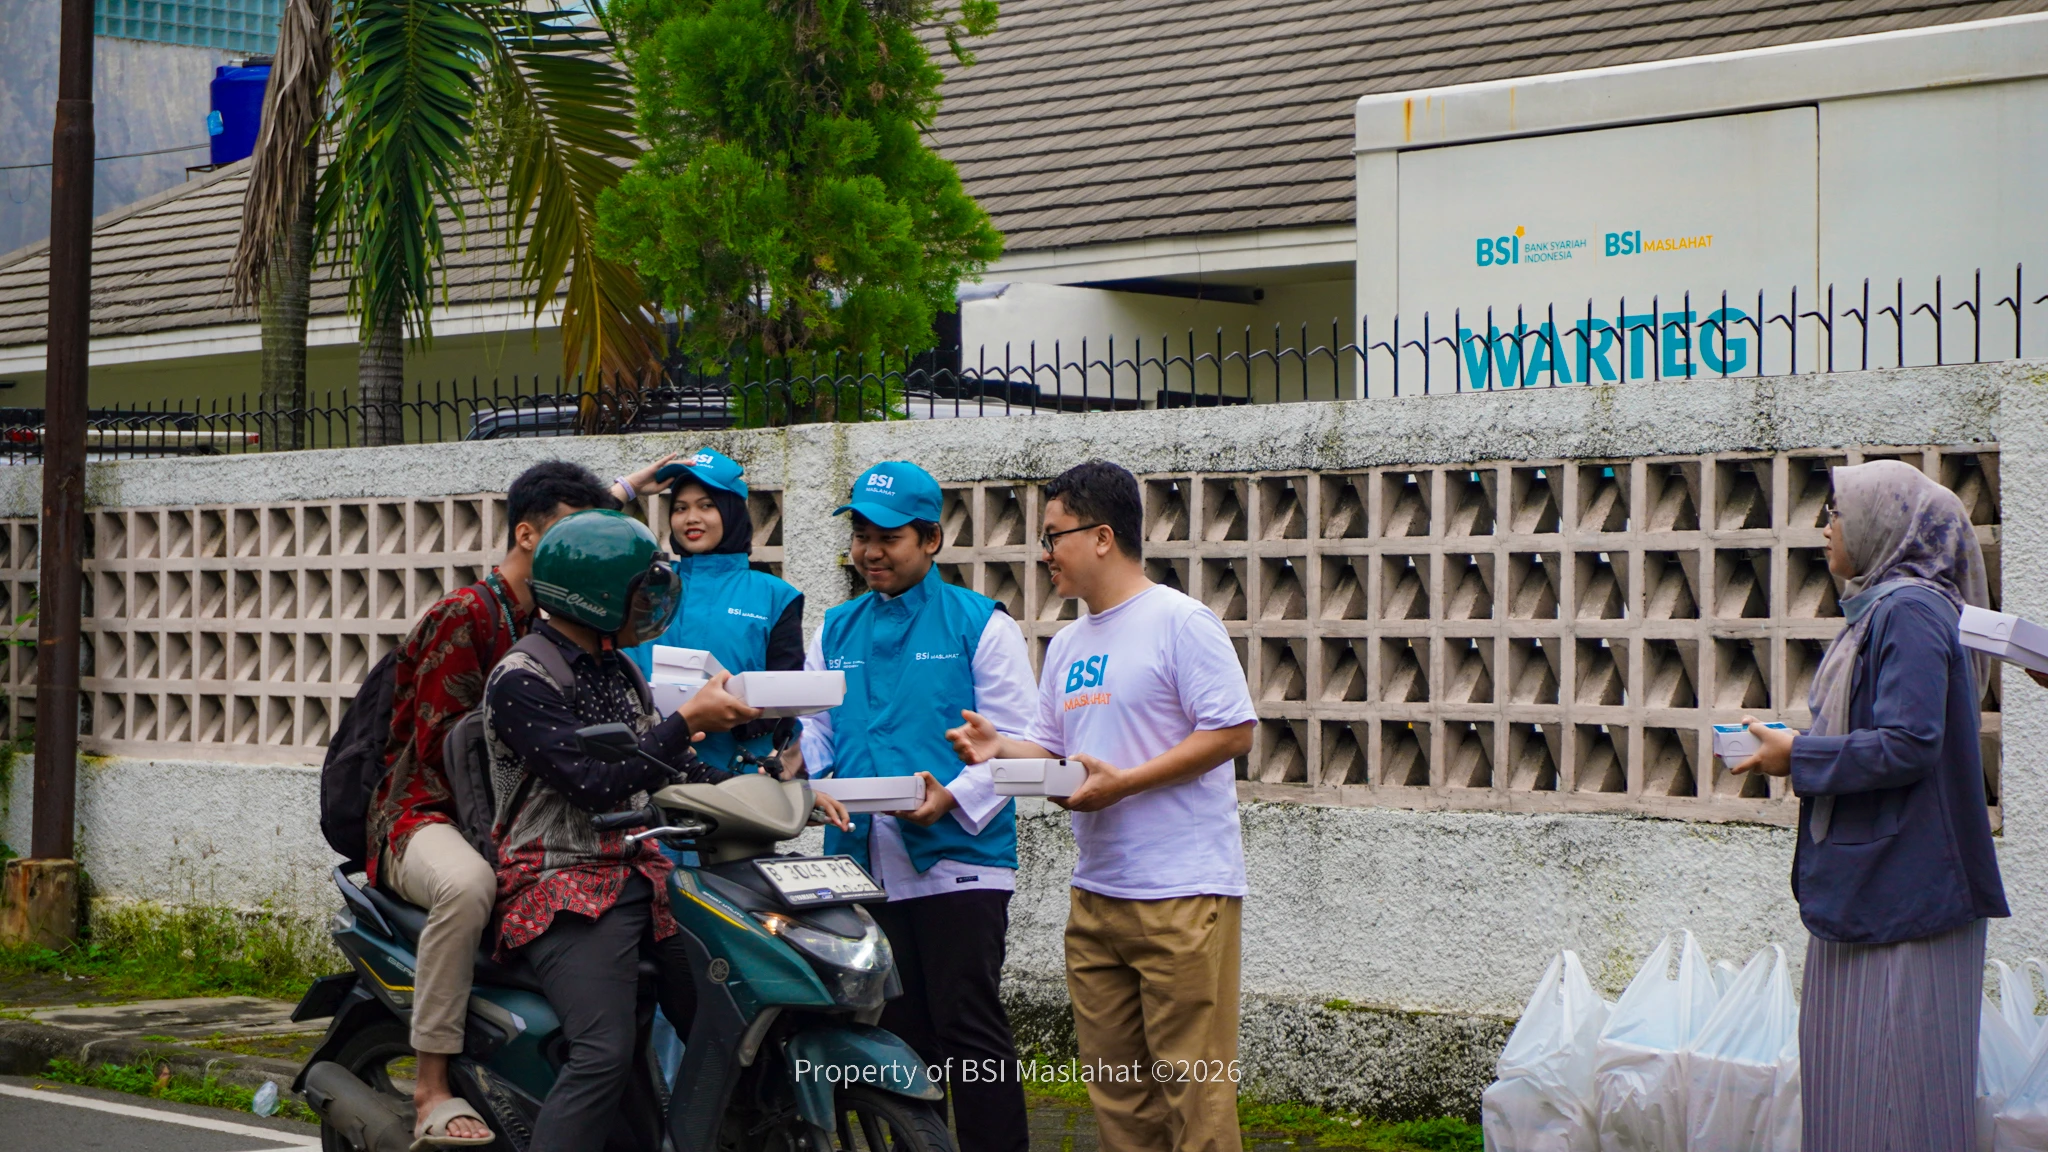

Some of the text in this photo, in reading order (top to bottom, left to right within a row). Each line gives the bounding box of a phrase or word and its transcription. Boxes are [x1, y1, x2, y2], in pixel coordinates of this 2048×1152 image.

[1477, 236, 1519, 266] BSI
[1524, 239, 1586, 252] BANK SYARIAH
[1605, 230, 1713, 257] BSI MASLAHAT
[1524, 251, 1572, 263] INDONESIA
[1459, 307, 1747, 389] WARTEG
[867, 474, 894, 489] BSI
[566, 593, 607, 617] Classic
[728, 607, 742, 616] BSI
[915, 652, 930, 661] BSI
[1065, 654, 1109, 694] BSI
[766, 866, 783, 881] B
[783, 863, 828, 880] 3049
[702, 890, 745, 919] SPORT UTILITY
